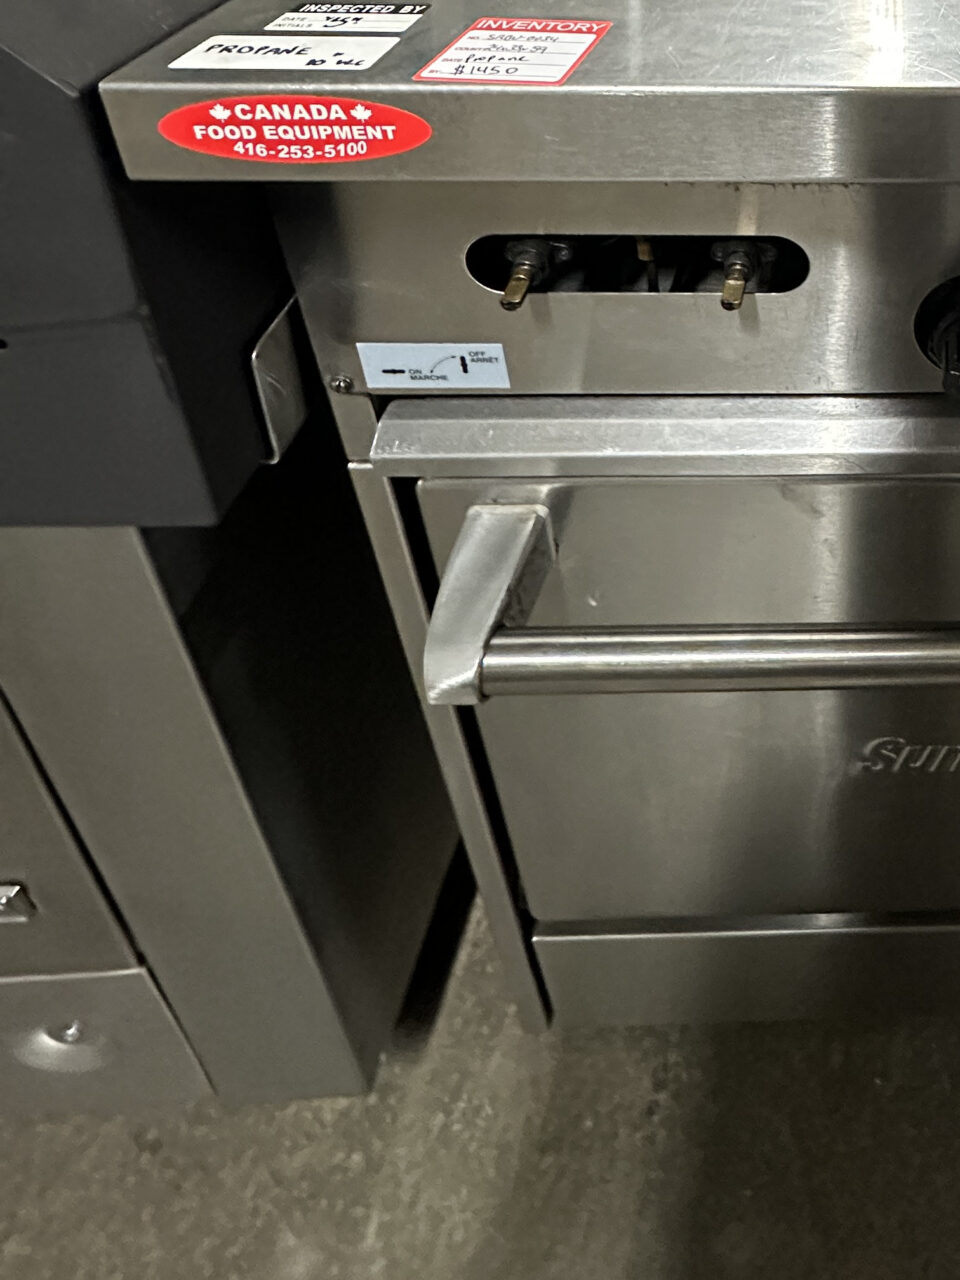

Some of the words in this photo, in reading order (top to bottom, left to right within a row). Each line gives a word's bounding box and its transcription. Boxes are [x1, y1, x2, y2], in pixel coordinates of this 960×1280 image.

[299, 4, 396, 13] INSPECTED
[399, 5, 427, 14] BY
[475, 20, 607, 32] INVENTORY
[203, 44, 312, 55] PROPANE
[454, 64, 518, 75] $1450
[234, 103, 348, 120] CANADA
[193, 125, 257, 140] FOOD
[262, 125, 397, 141] EQUIPMENT
[233, 140, 368, 159] 416-253-5100
